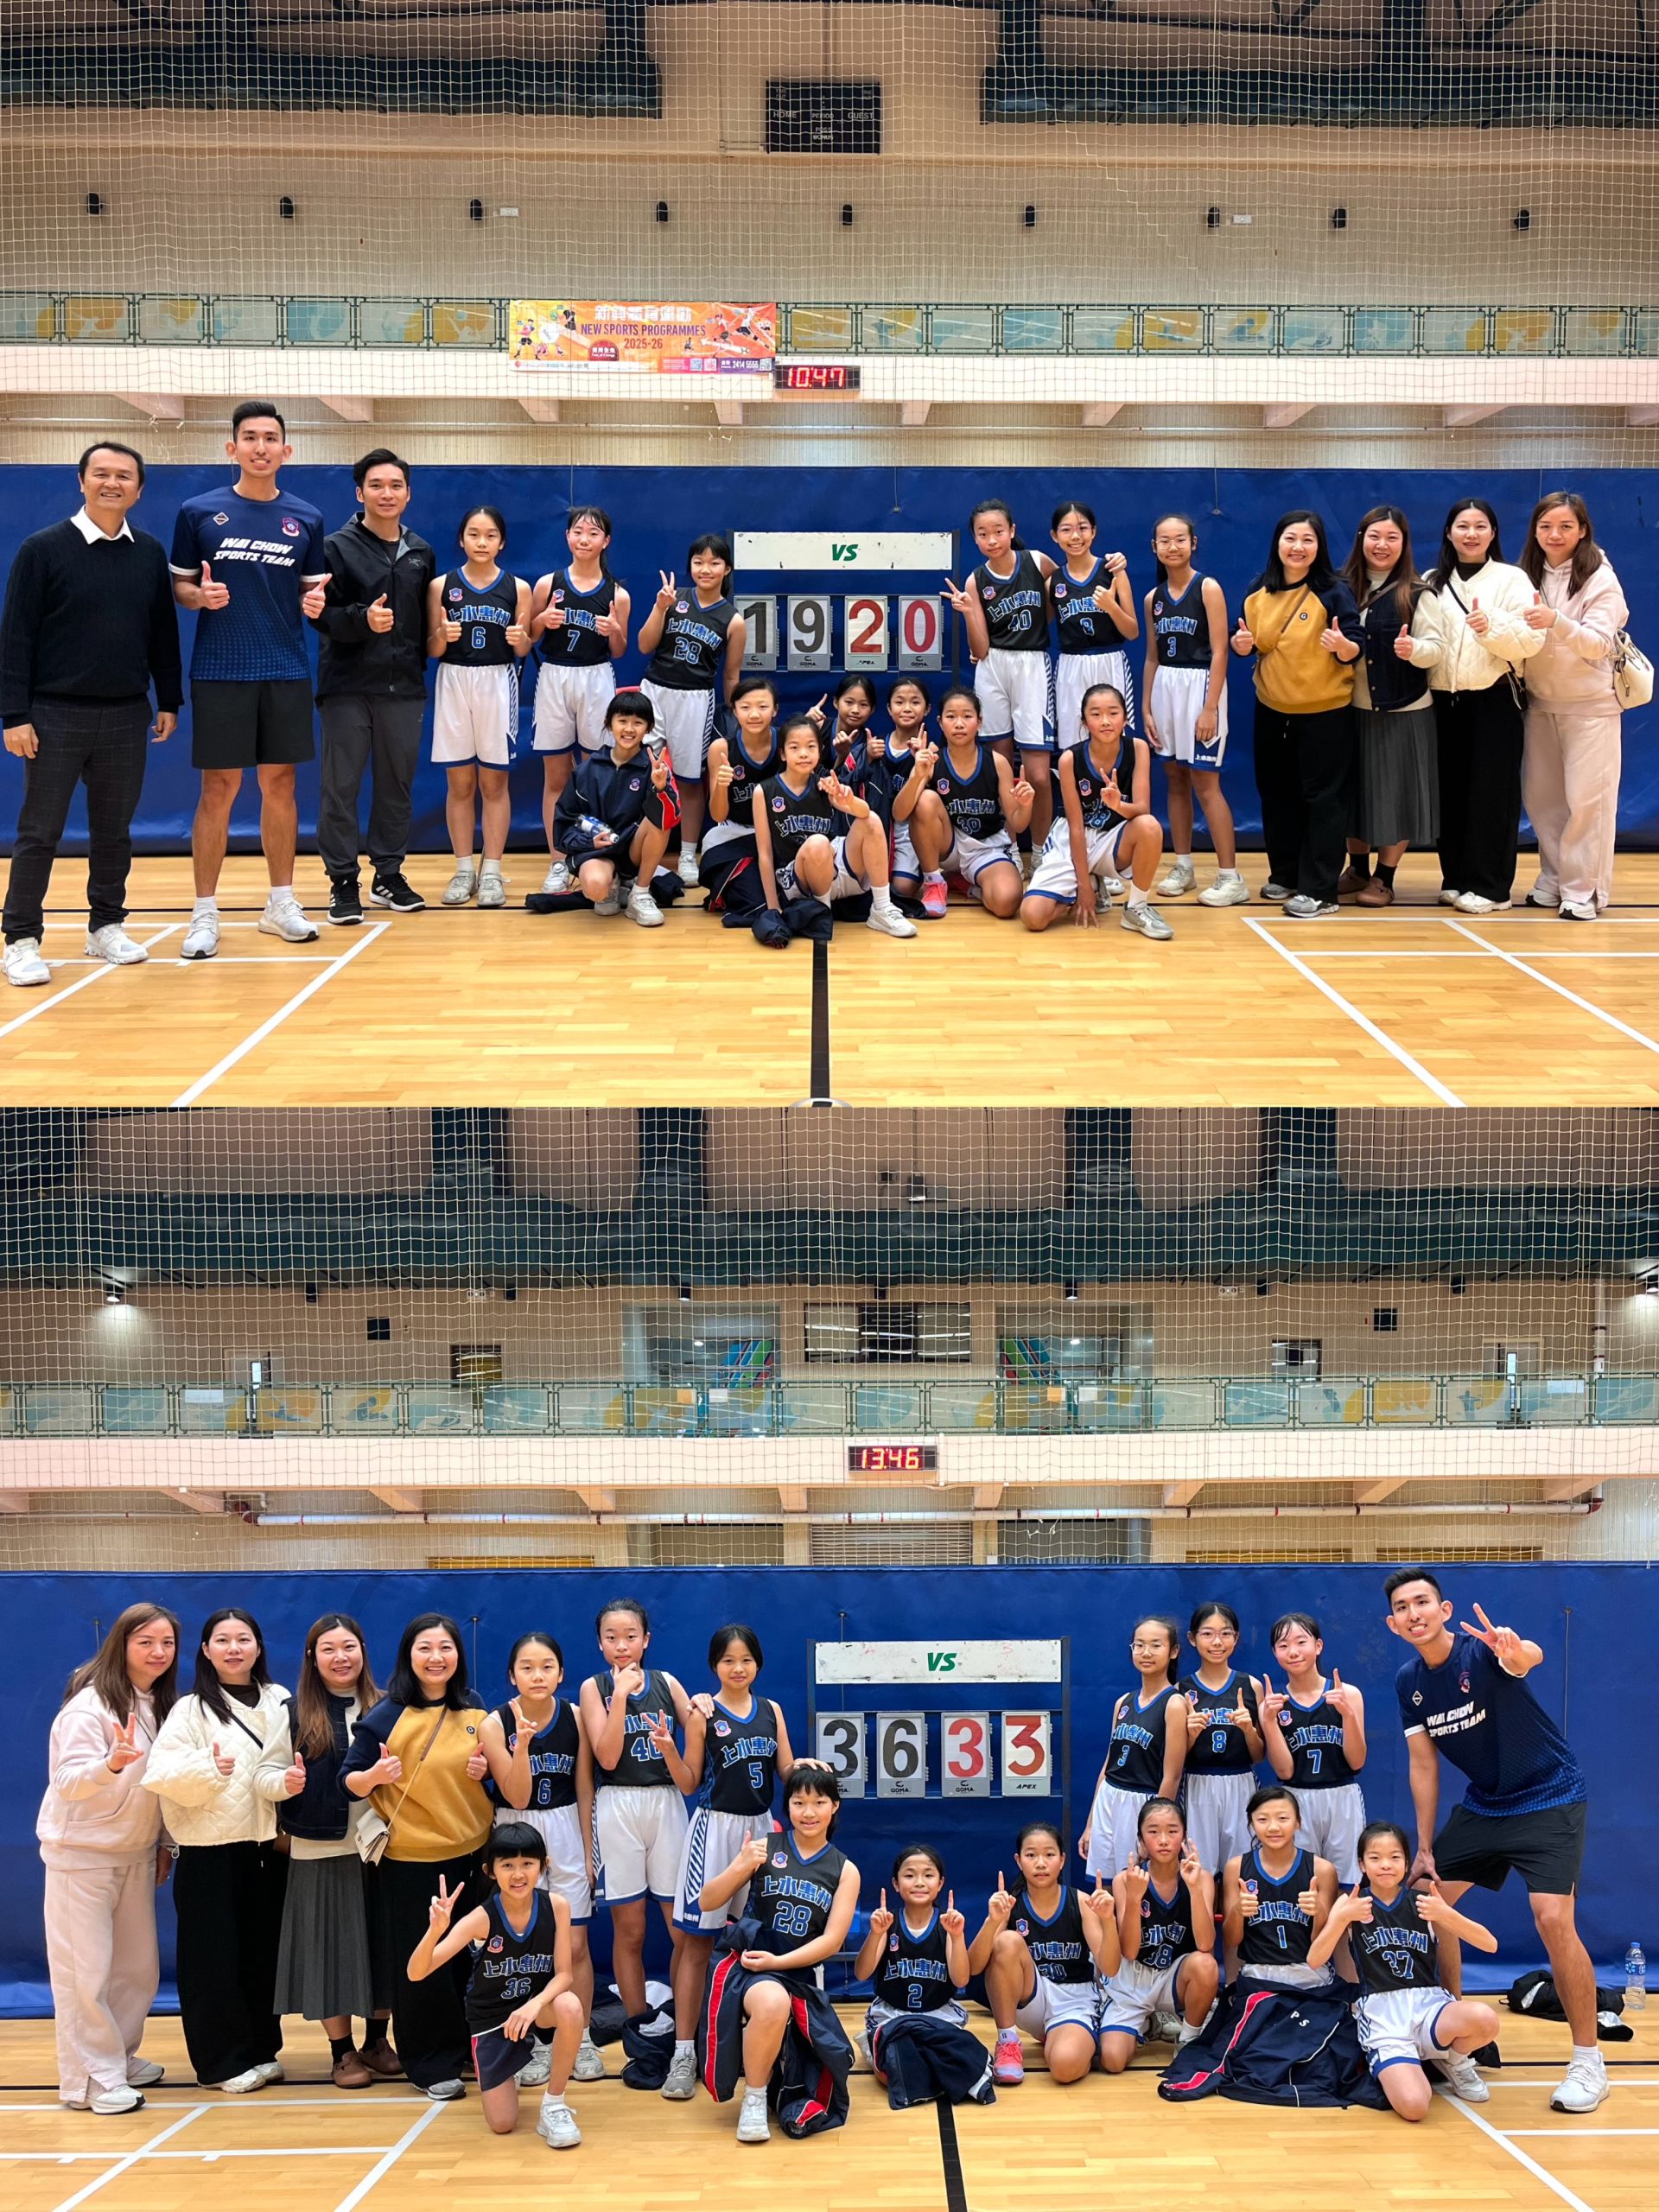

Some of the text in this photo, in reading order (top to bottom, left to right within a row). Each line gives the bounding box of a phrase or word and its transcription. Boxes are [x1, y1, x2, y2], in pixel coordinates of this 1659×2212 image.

[581, 323, 706, 336] NEW SPORTS PROGRAMMES
[624, 338, 663, 350] 2025-26
[786, 366, 844, 388] 10:47
[219, 537, 293, 555] WAI CHOW
[831, 543, 858, 561] VS
[213, 550, 296, 567] SPORTS TEAM
[563, 607, 600, 635] 水惠
[1007, 609, 1032, 632] 40
[1058, 596, 1109, 623] 上水惠
[472, 626, 486, 649] 6
[1154, 616, 1198, 640] 水惠州
[567, 630, 581, 652] 7
[673, 636, 702, 664] 28
[1167, 636, 1176, 657] 3
[946, 798, 995, 815] 水惠州
[861, 1448, 919, 1469] 13:46
[927, 1652, 957, 1671] VS
[624, 1713, 673, 1736] 水惠州
[1427, 1712, 1446, 1726] WAI
[1429, 1708, 1485, 1738] SPORTS TEAM
[1113, 1723, 1154, 1750] 水惠州
[1212, 1730, 1226, 1752] 8
[530, 1752, 575, 1775] 水惠州
[1117, 1745, 1130, 1766] 3
[1306, 1749, 1322, 1774] 7
[748, 1762, 764, 1788] 5
[537, 1778, 551, 1804] 6
[761, 1875, 832, 1912] 上水惠州
[772, 1901, 811, 1936] 28
[1277, 1925, 1287, 1948] 1
[1028, 1942, 1082, 1961] 水惠州
[1382, 1950, 1414, 1979] 37
[501, 1977, 531, 1999] 36
[907, 1984, 923, 2008] 2
